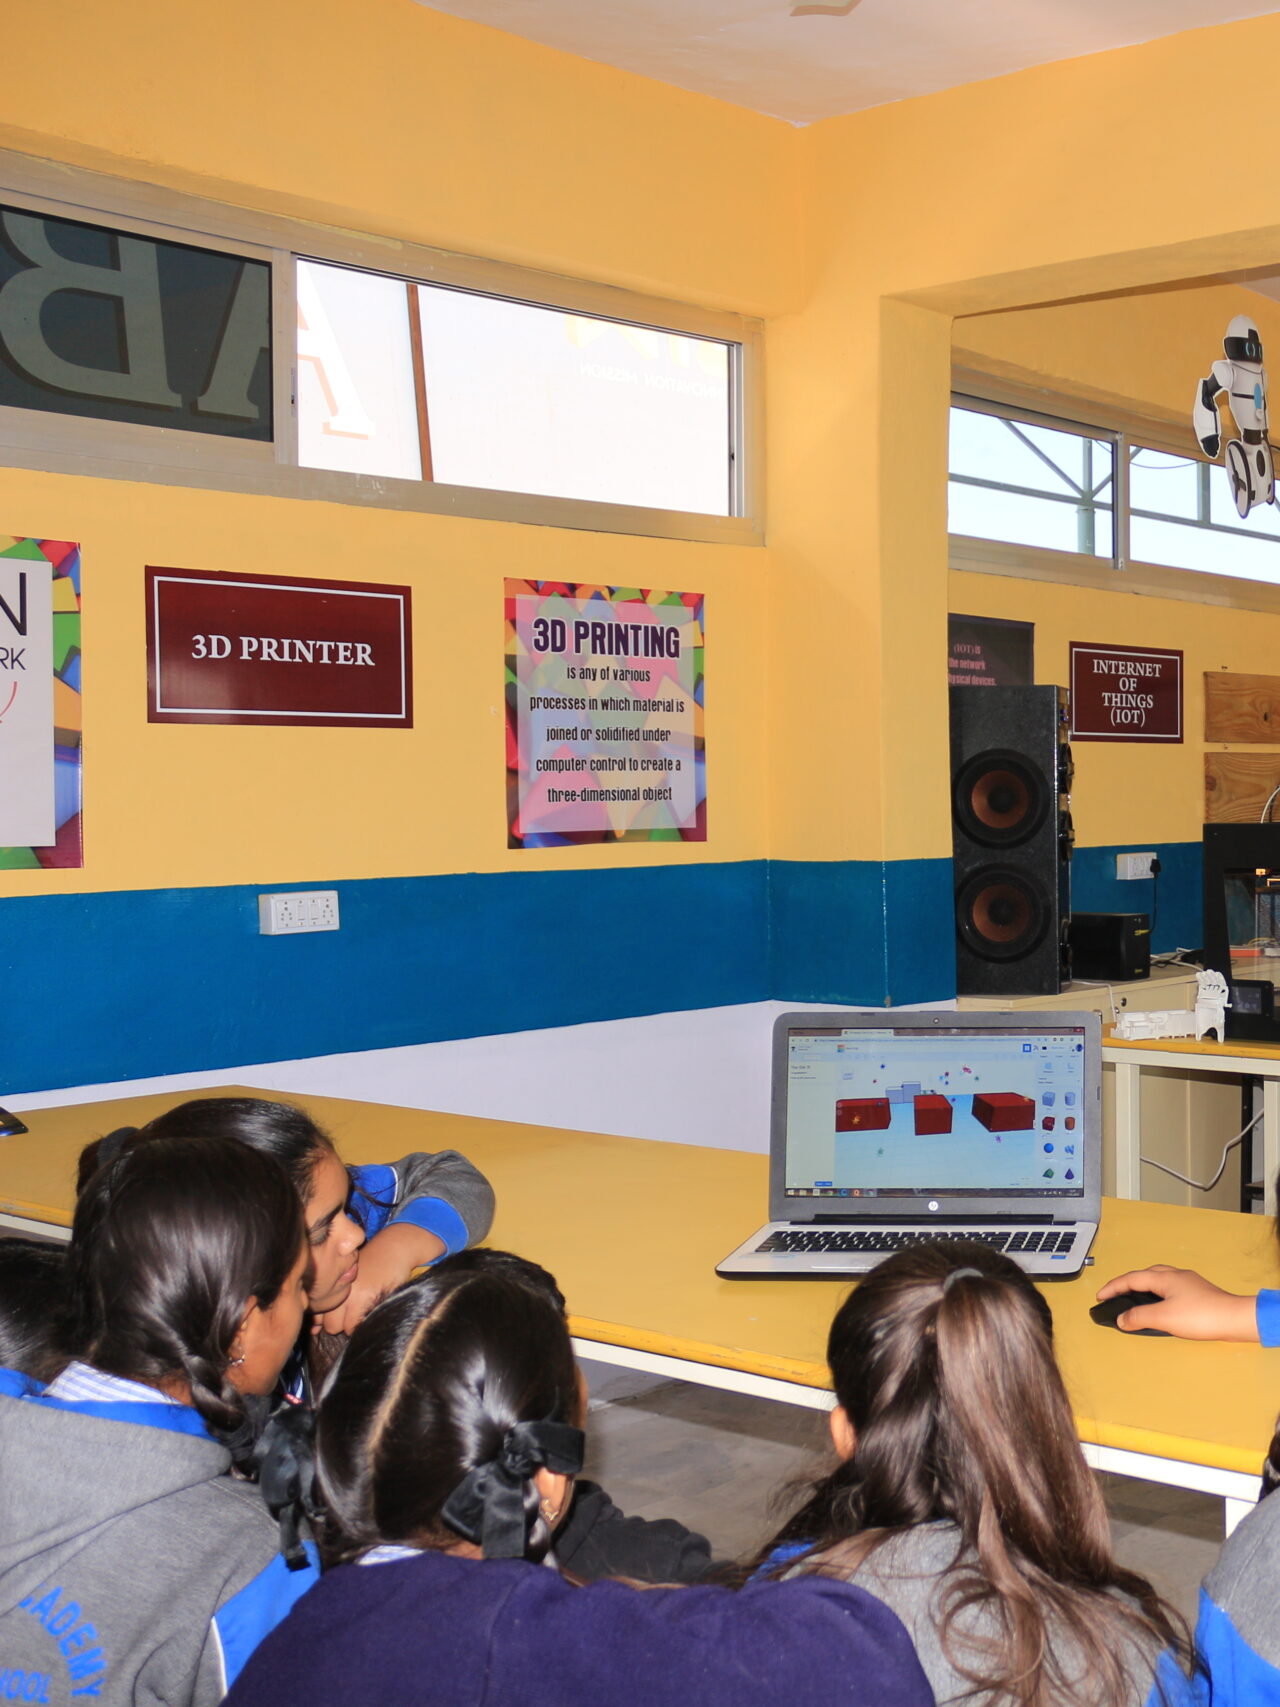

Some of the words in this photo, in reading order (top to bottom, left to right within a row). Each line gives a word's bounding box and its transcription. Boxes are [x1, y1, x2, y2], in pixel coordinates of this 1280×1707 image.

[533, 618, 566, 653] 3D
[574, 620, 680, 659] PRINTING
[191, 634, 232, 660] 3D
[239, 635, 376, 667] PRINTER
[566, 666, 577, 679] is
[579, 667, 597, 682] any
[600, 667, 609, 680] of
[612, 668, 651, 682] various
[1093, 659, 1162, 678] INTERNET
[1119, 677, 1138, 692] OF
[530, 696, 586, 711] processes
[589, 696, 598, 710] in
[601, 698, 631, 711] which
[633, 698, 674, 712] material
[676, 698, 685, 713] is
[1102, 692, 1154, 709] THINGS
[1110, 707, 1146, 727] (IOT)
[546, 726, 578, 742] joined
[581, 729, 593, 741] or
[595, 727, 640, 742] solidified
[642, 728, 671, 742] under
[536, 758, 587, 772] computer
[590, 757, 627, 771] control
[629, 757, 639, 771] to
[640, 757, 673, 771] create
[675, 761, 681, 771] a
[547, 787, 640, 803] three-dimensional
[643, 786, 672, 802] object
